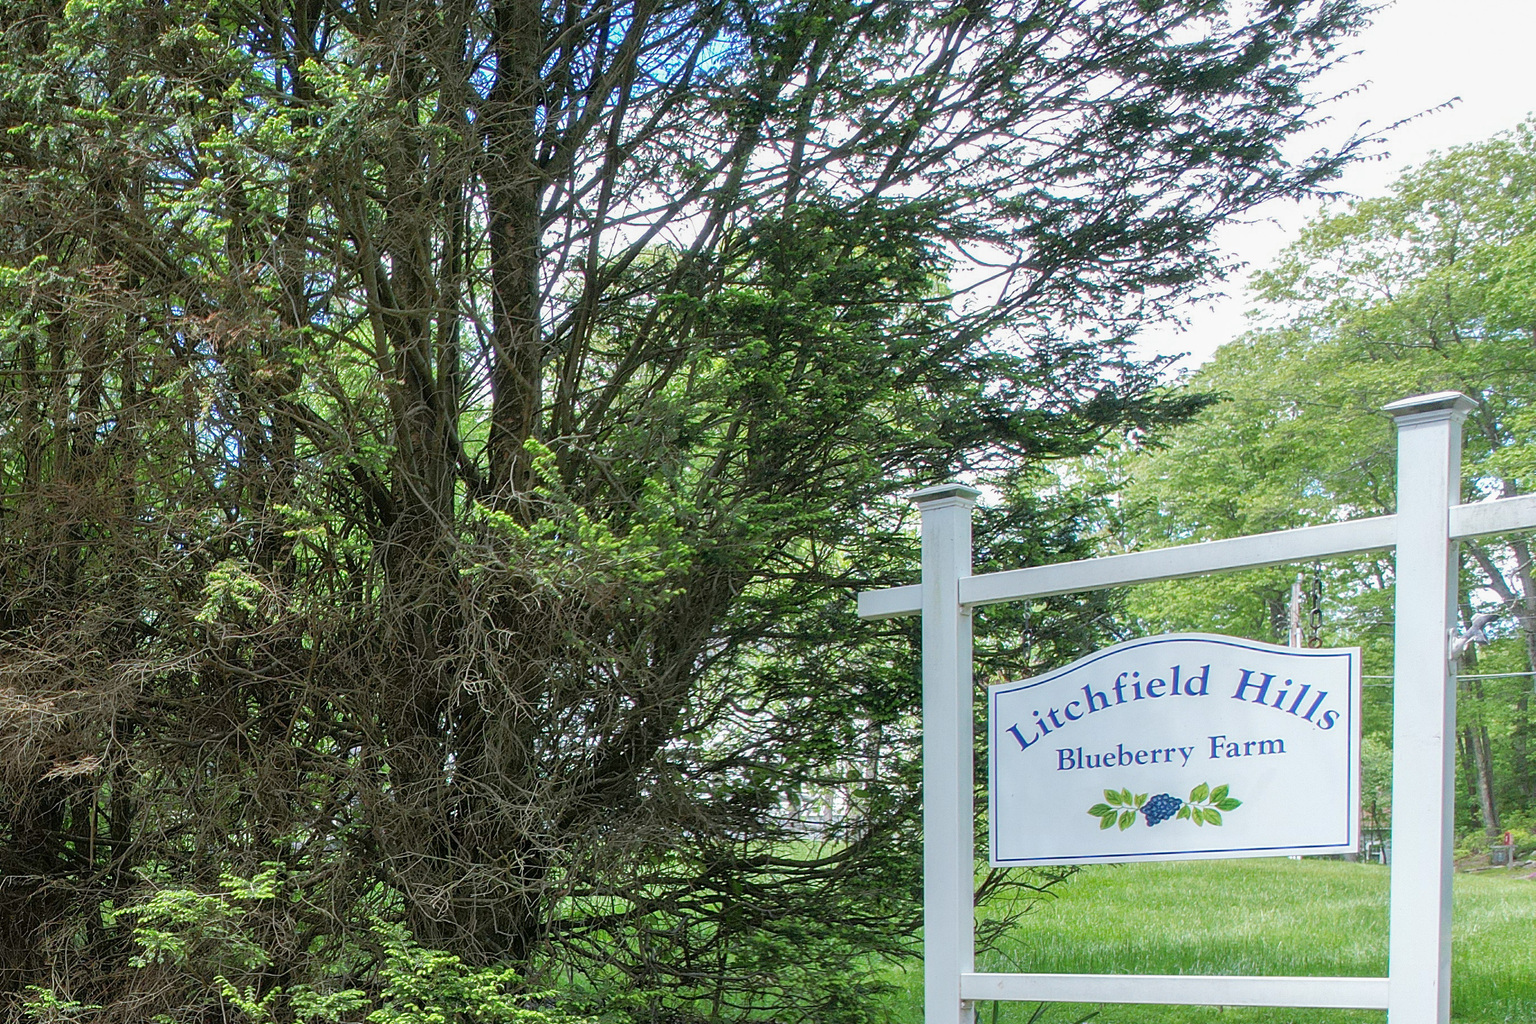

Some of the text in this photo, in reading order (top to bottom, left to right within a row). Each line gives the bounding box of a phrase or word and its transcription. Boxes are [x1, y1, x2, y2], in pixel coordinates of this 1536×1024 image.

[1006, 664, 1340, 751] Litchfield Hills
[1056, 734, 1286, 771] Blueberry Farm
